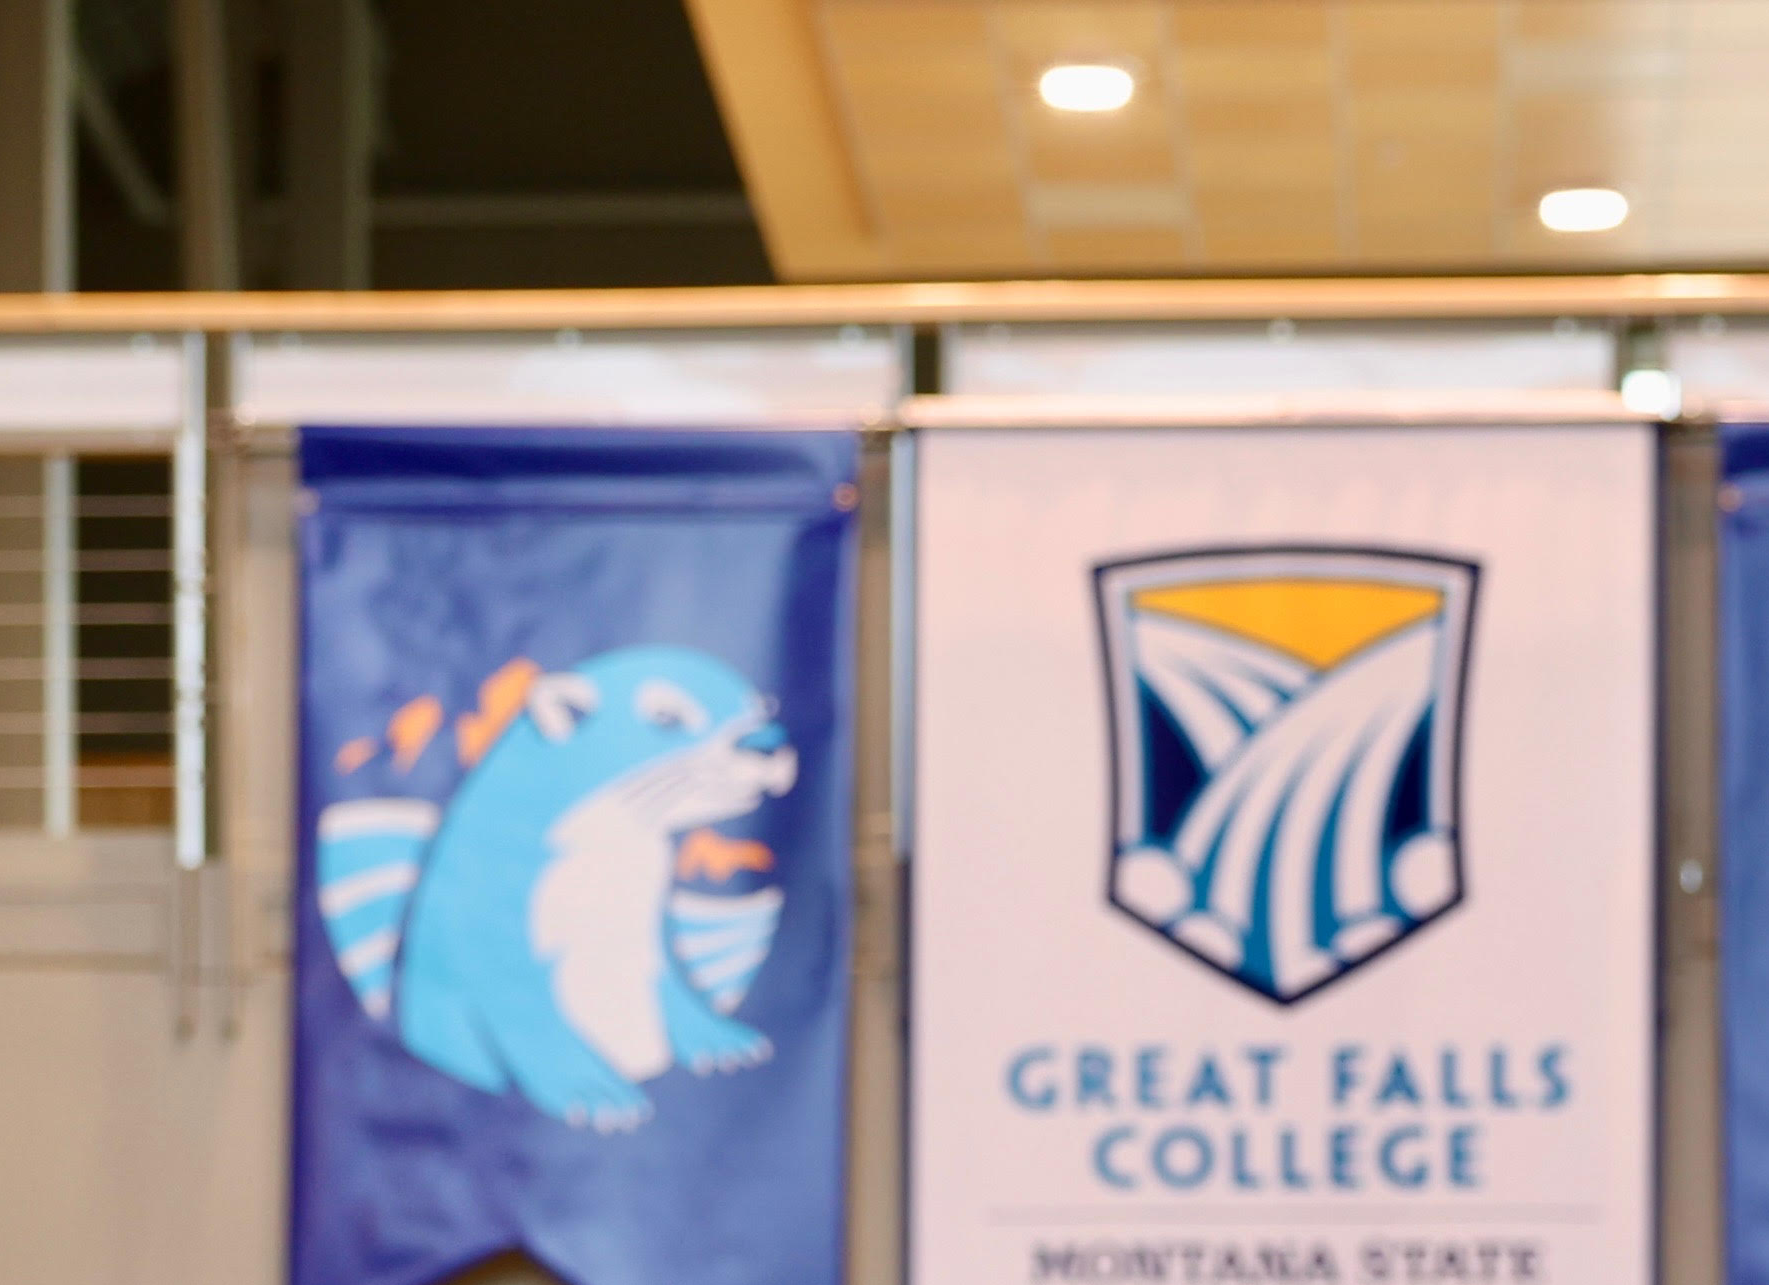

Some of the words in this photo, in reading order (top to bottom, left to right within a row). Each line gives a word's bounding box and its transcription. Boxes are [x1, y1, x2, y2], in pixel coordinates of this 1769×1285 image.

[1005, 1045, 1285, 1110] GREAT
[1329, 1044, 1570, 1110] FALLS
[1091, 1124, 1484, 1190] COLLEGE
